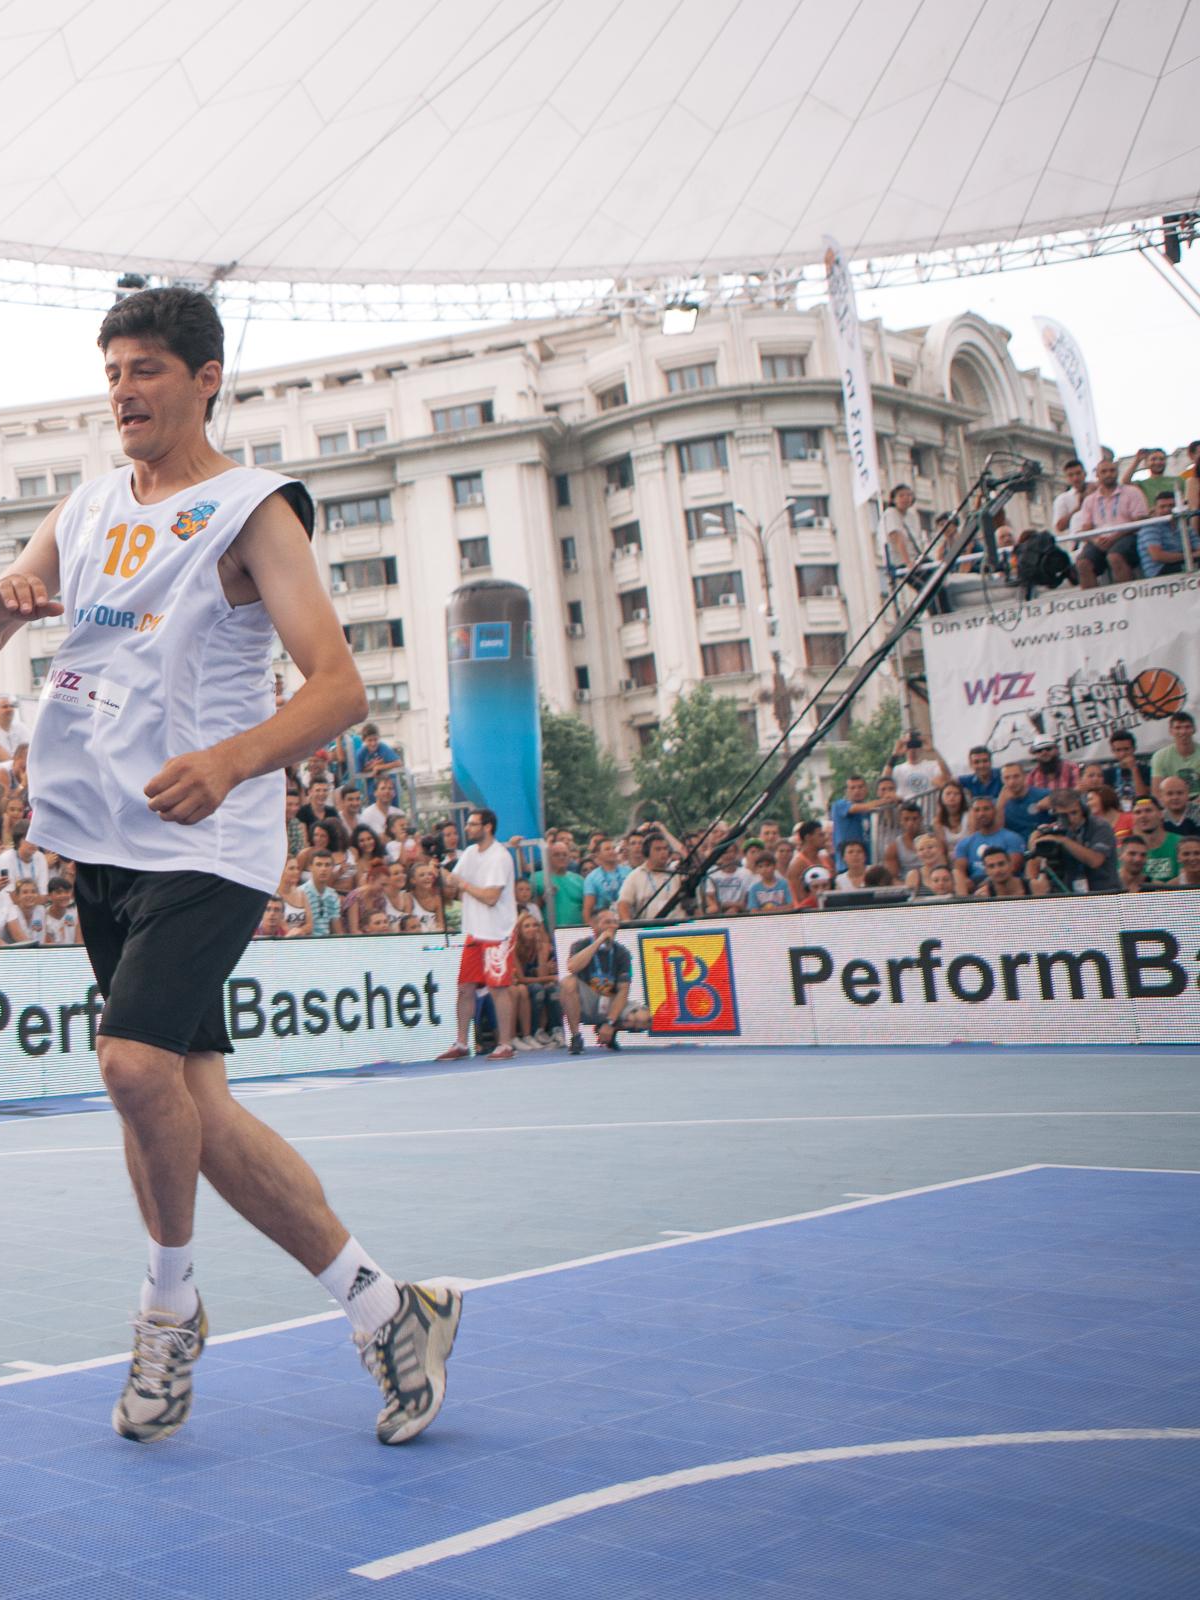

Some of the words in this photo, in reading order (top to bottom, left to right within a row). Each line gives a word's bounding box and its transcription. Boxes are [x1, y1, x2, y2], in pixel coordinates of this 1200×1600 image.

[103, 523, 156, 578] 18
[932, 622, 960, 635] Din
[1046, 591, 1117, 615] Jocurile
[1048, 683, 1129, 705] SPORT
[987, 698, 1136, 752] ARENA
[788, 928, 1200, 1006] PerformB
